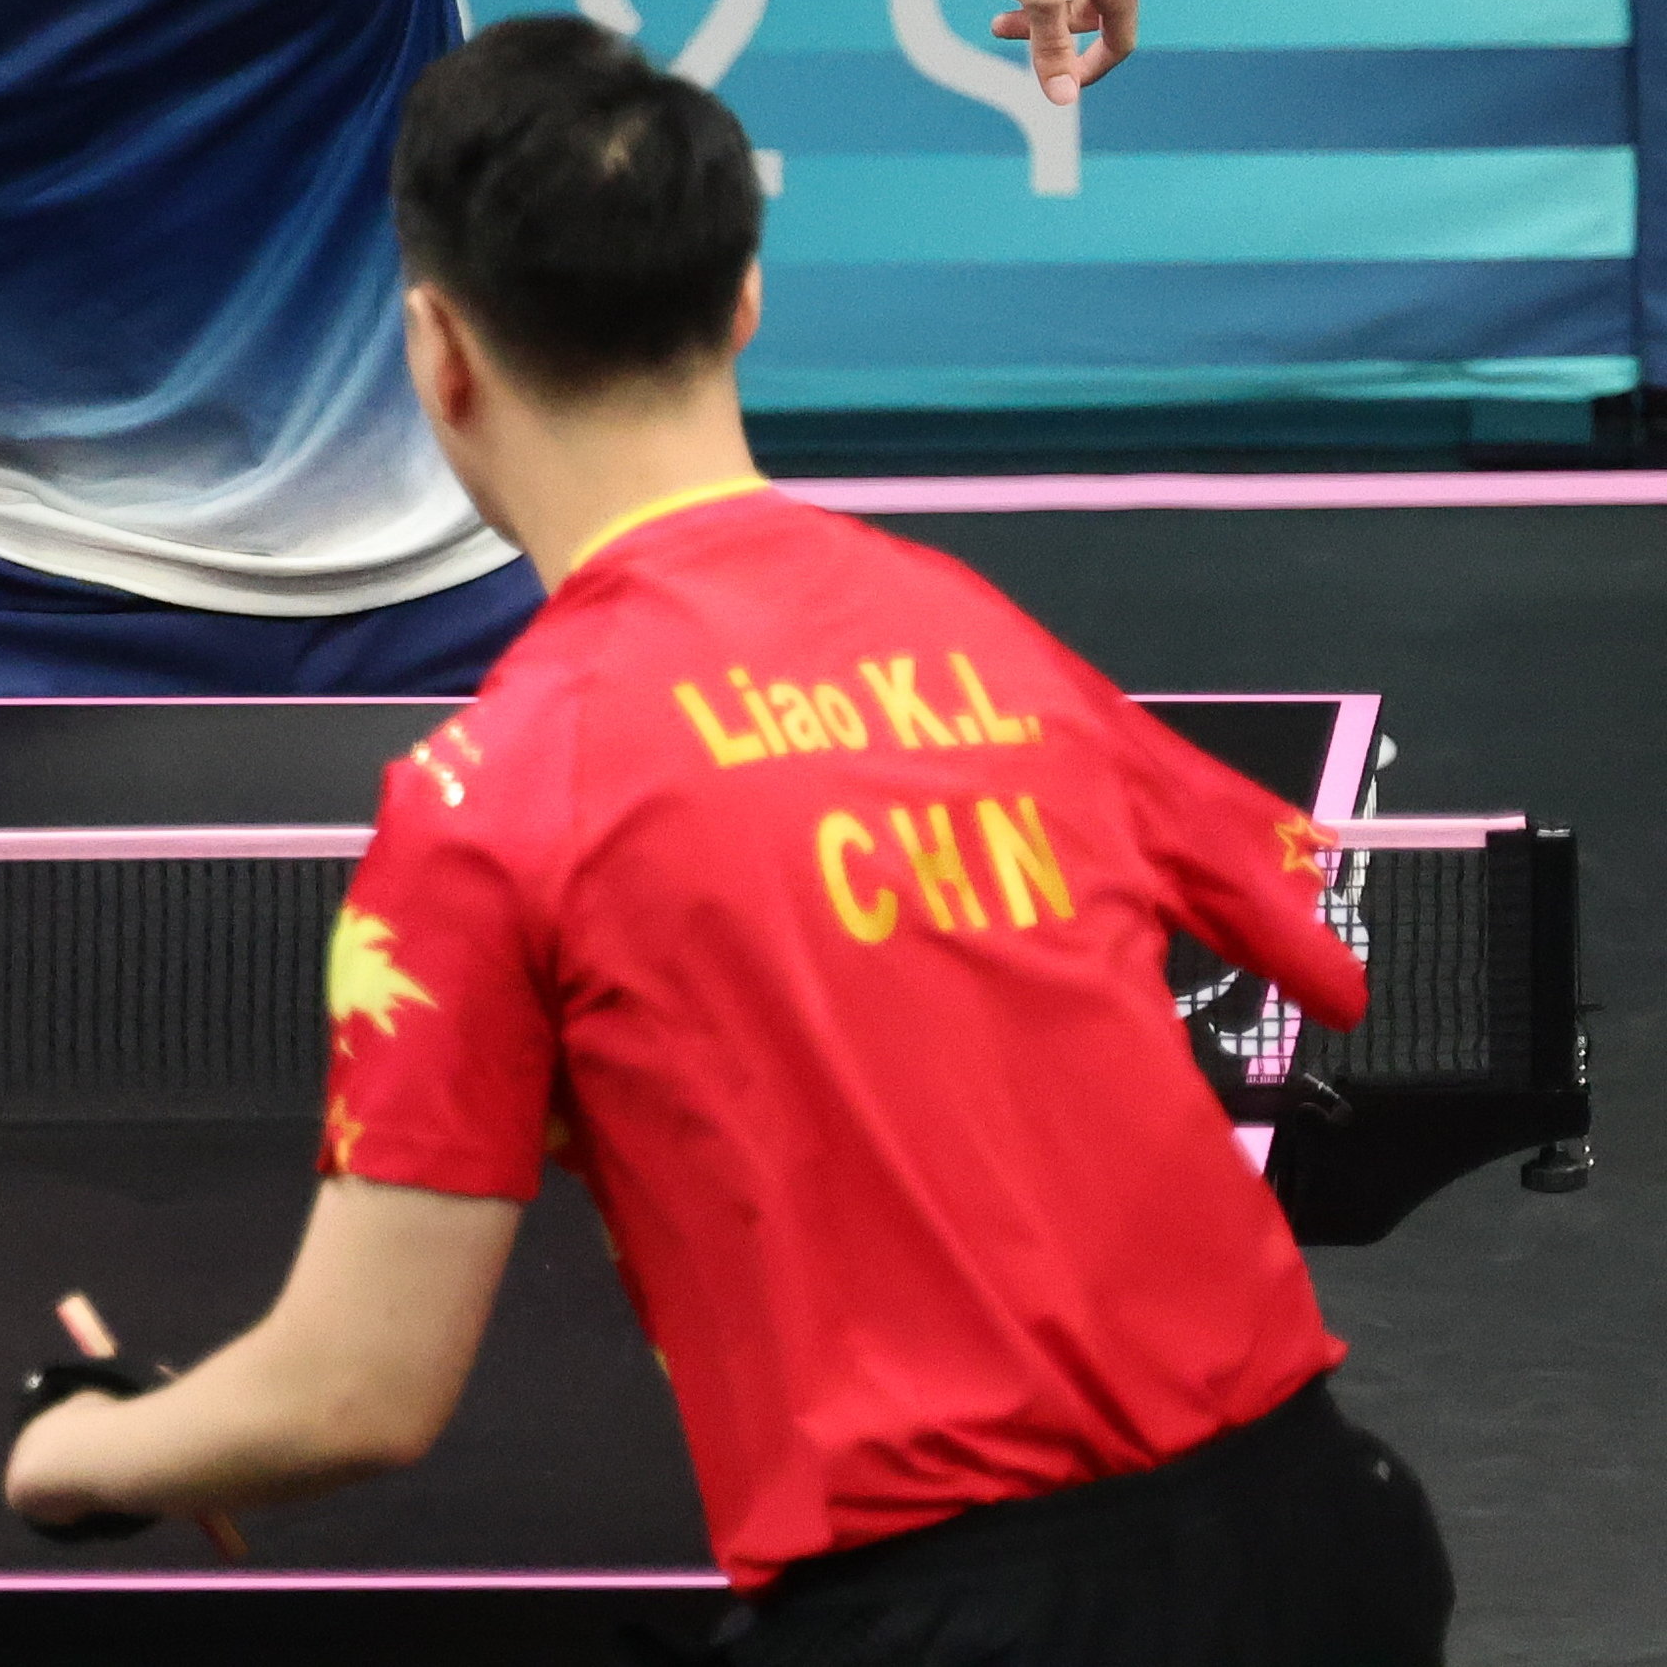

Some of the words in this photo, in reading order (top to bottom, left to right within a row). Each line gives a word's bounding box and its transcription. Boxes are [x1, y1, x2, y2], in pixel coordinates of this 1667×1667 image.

[672, 667, 869, 770] Liao
[856, 650, 1043, 752] K.L.
[814, 795, 1077, 945] CHN
